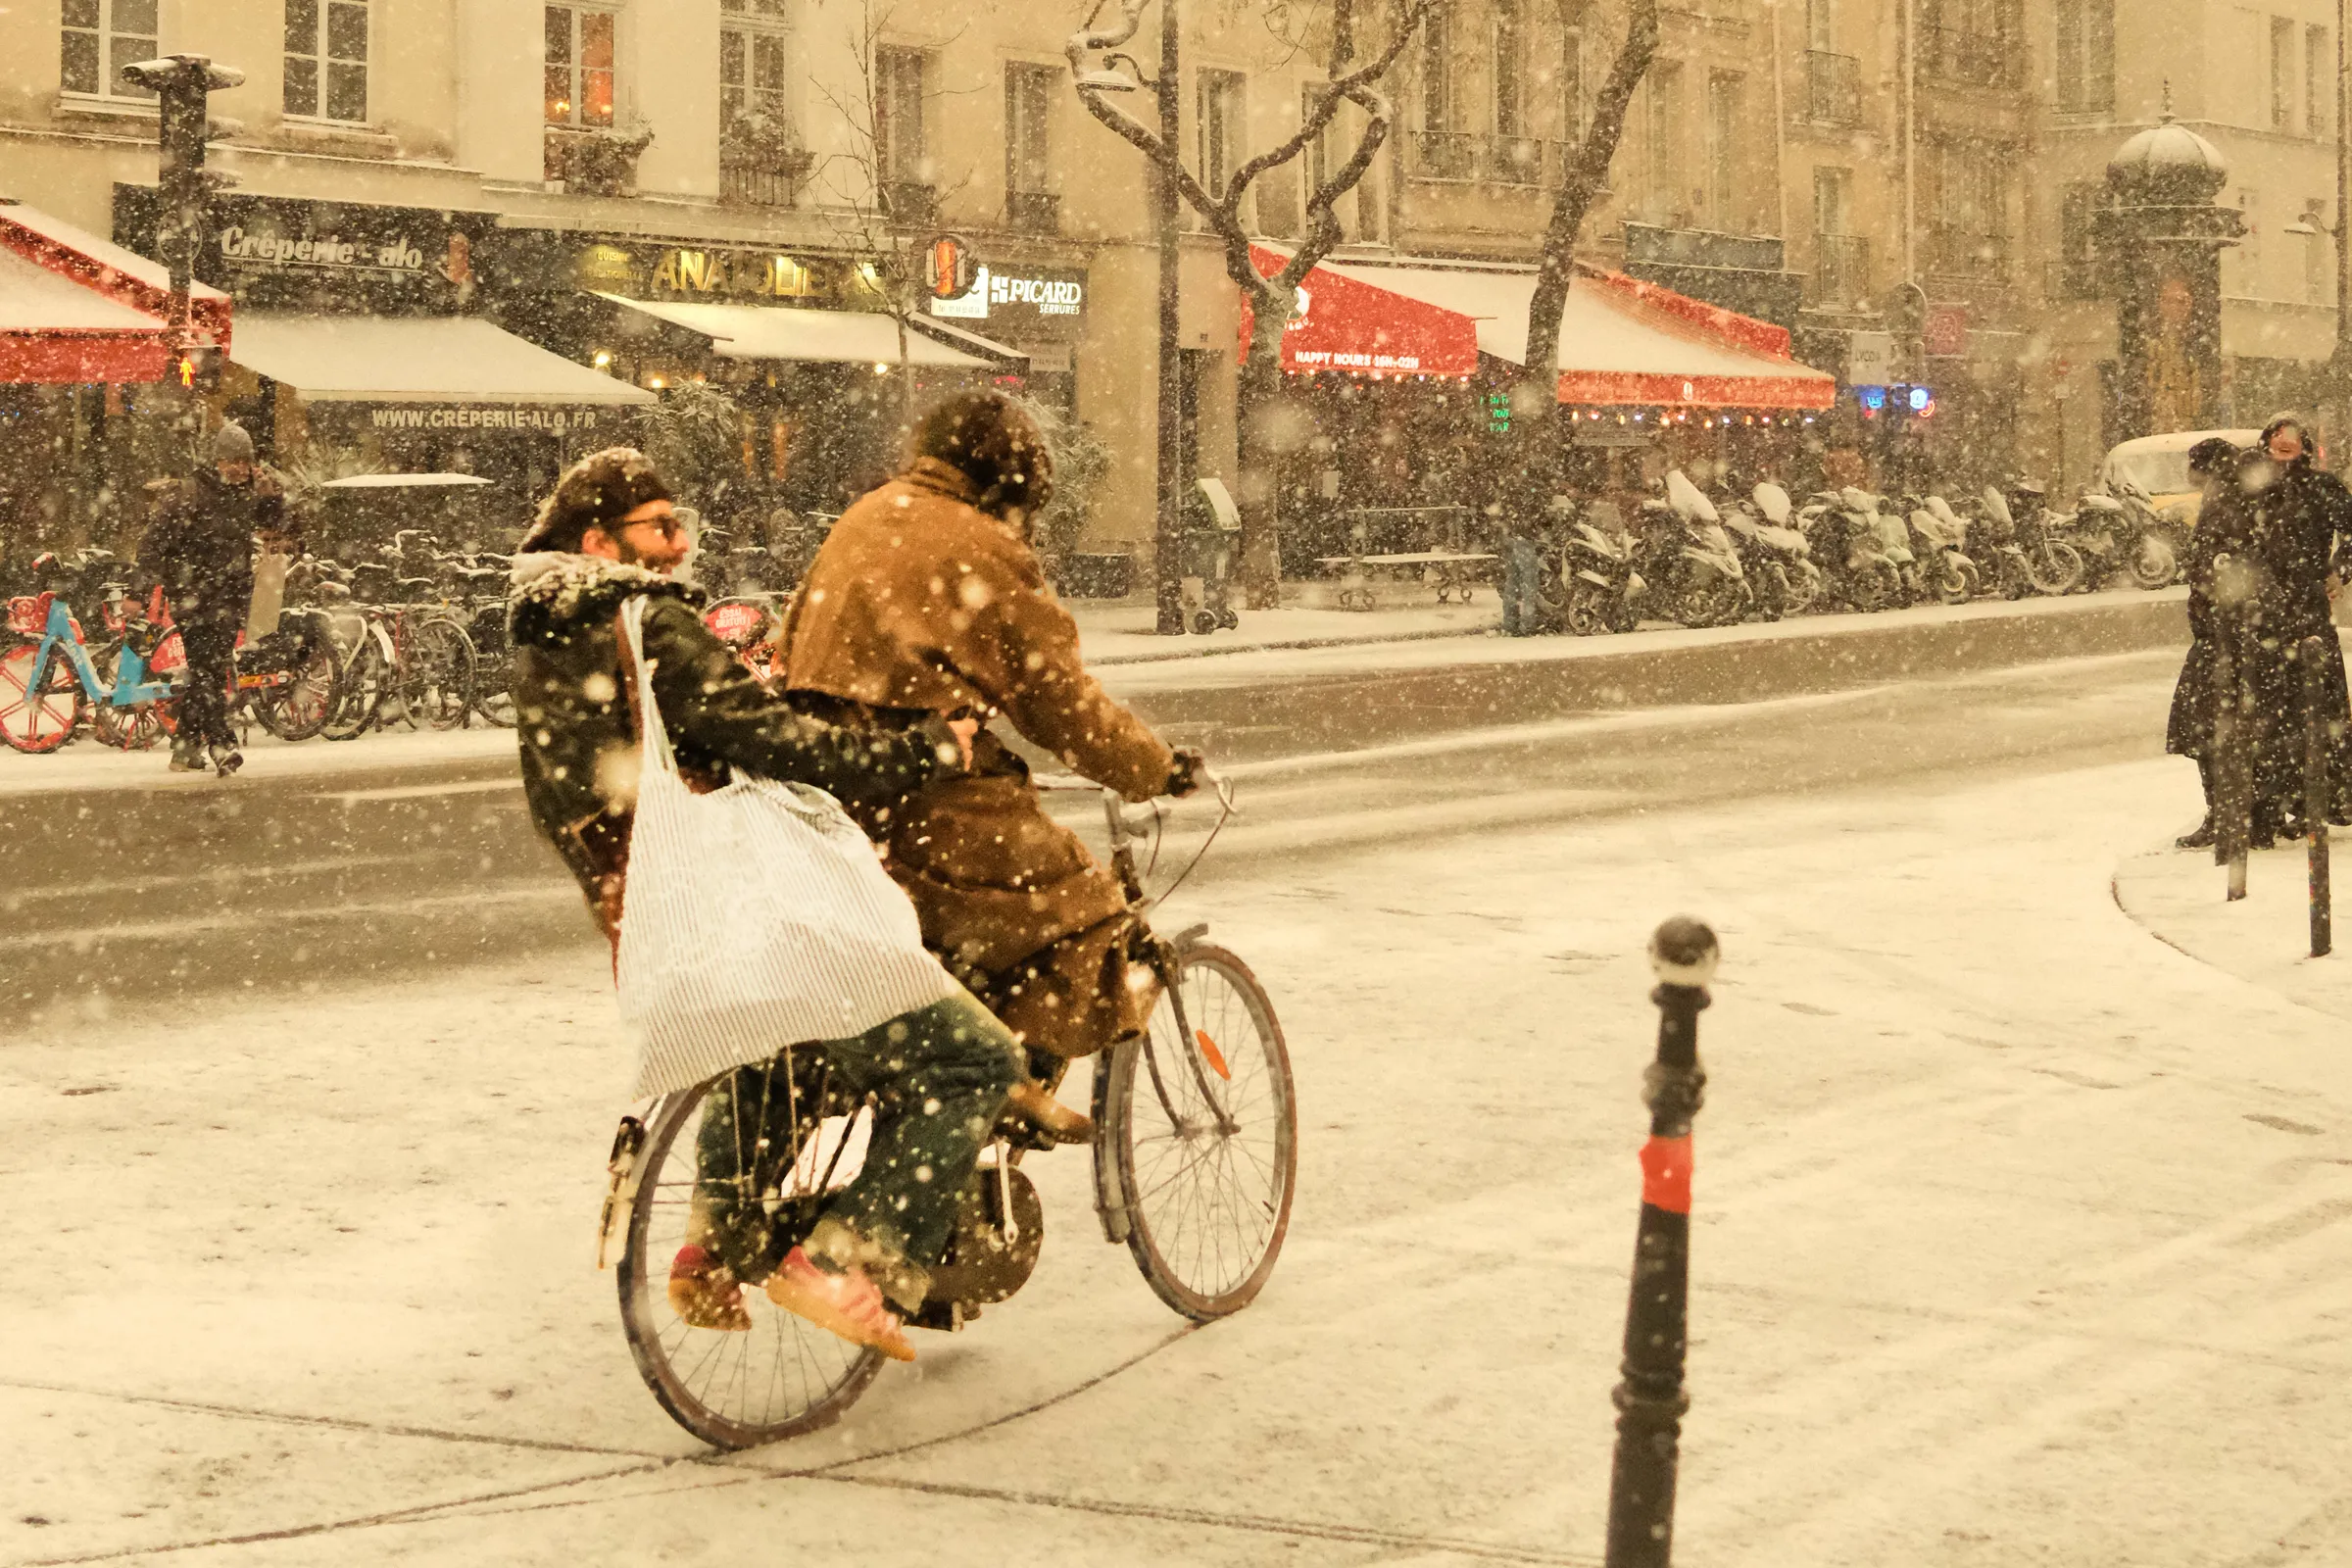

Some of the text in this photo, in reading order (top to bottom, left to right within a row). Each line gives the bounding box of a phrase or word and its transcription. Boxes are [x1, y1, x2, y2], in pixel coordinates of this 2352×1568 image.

[221, 226, 355, 265] Crêperie
[379, 238, 422, 269] alo
[1009, 279, 1082, 305] PICARD
[1039, 303, 1080, 315] SERRURES
[1296, 350, 1331, 365] HAPPY
[1334, 353, 1371, 367] HOURS
[719, 607, 742, 619] ESSAI
